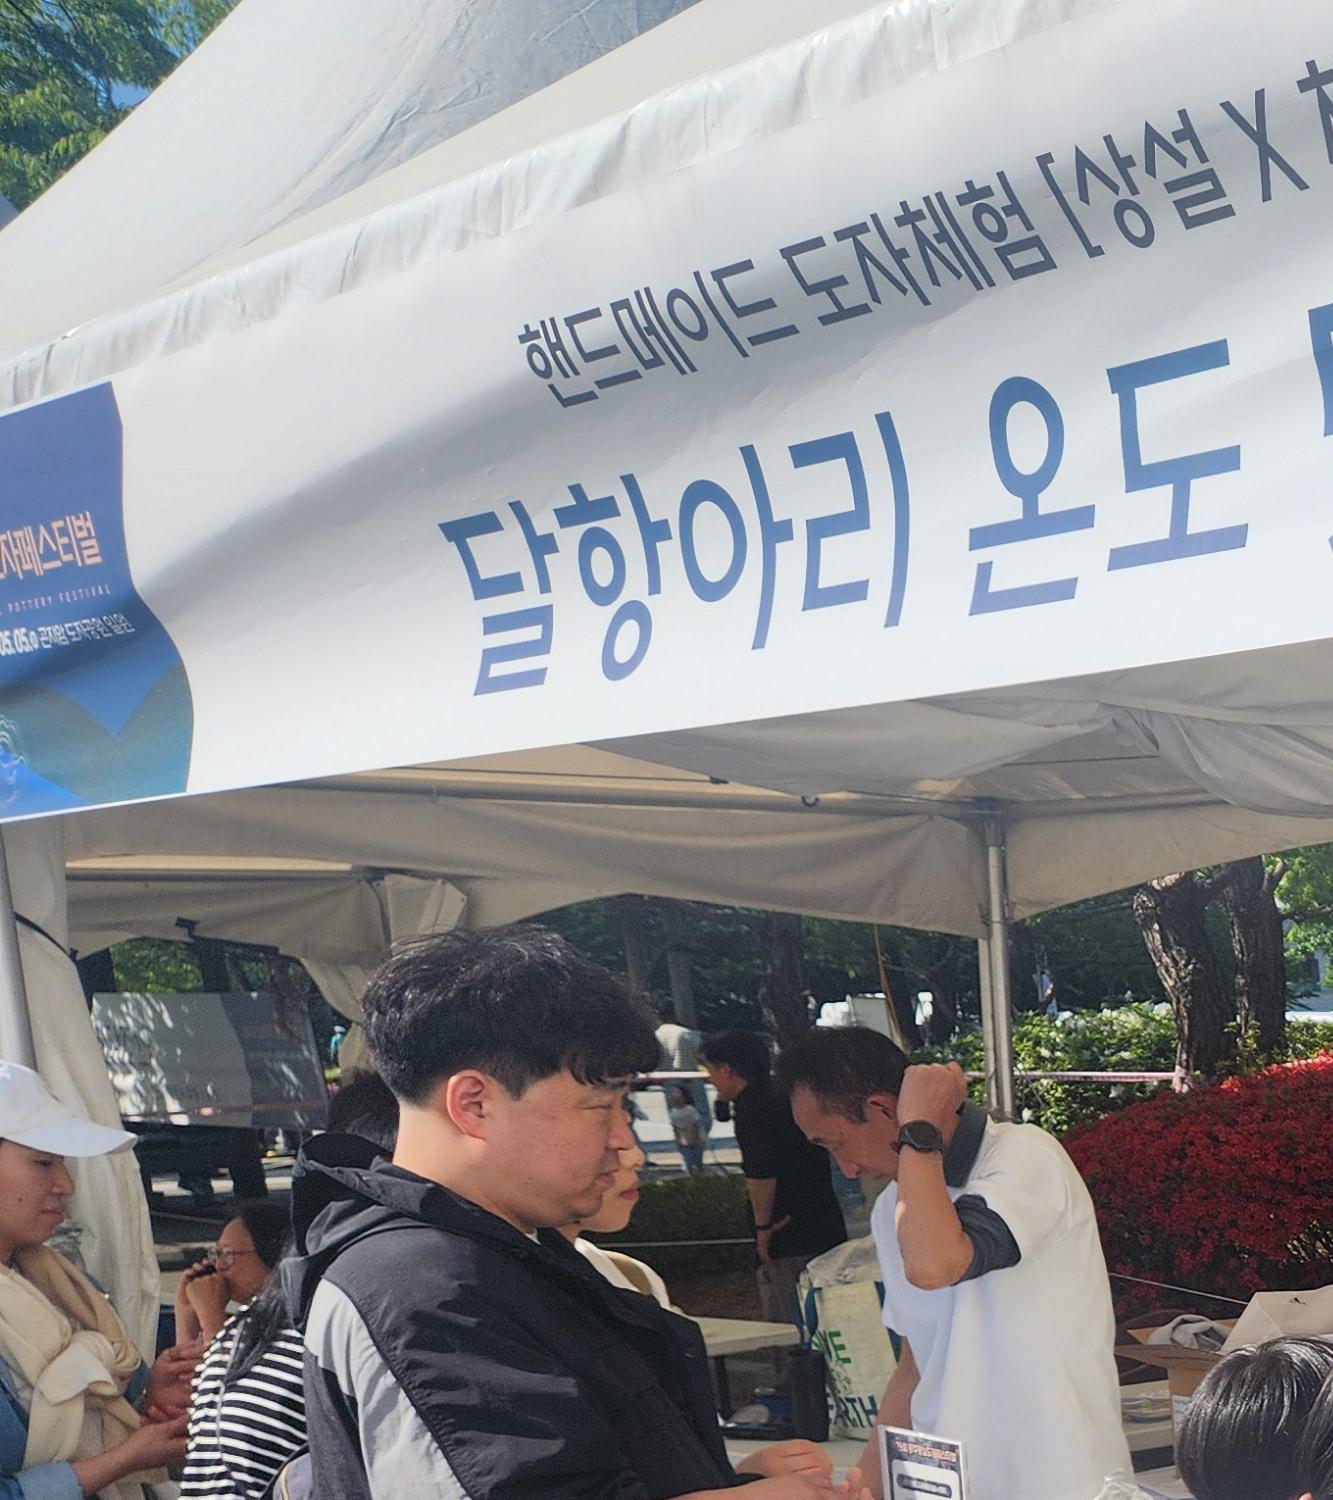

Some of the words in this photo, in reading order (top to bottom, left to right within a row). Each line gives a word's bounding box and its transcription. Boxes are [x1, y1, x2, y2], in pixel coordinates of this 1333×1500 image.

[517, 258, 798, 410] 핸드메이드
[781, 171, 1057, 330] 도자체험
[1037, 106, 1236, 255] [상설
[1219, 88, 1312, 203] X
[0, 511, 102, 580] 자페스티벌
[59, 584, 111, 603] FESTIVAL
[438, 411, 912, 697] 달항아리
[967, 337, 1251, 618] 온도
